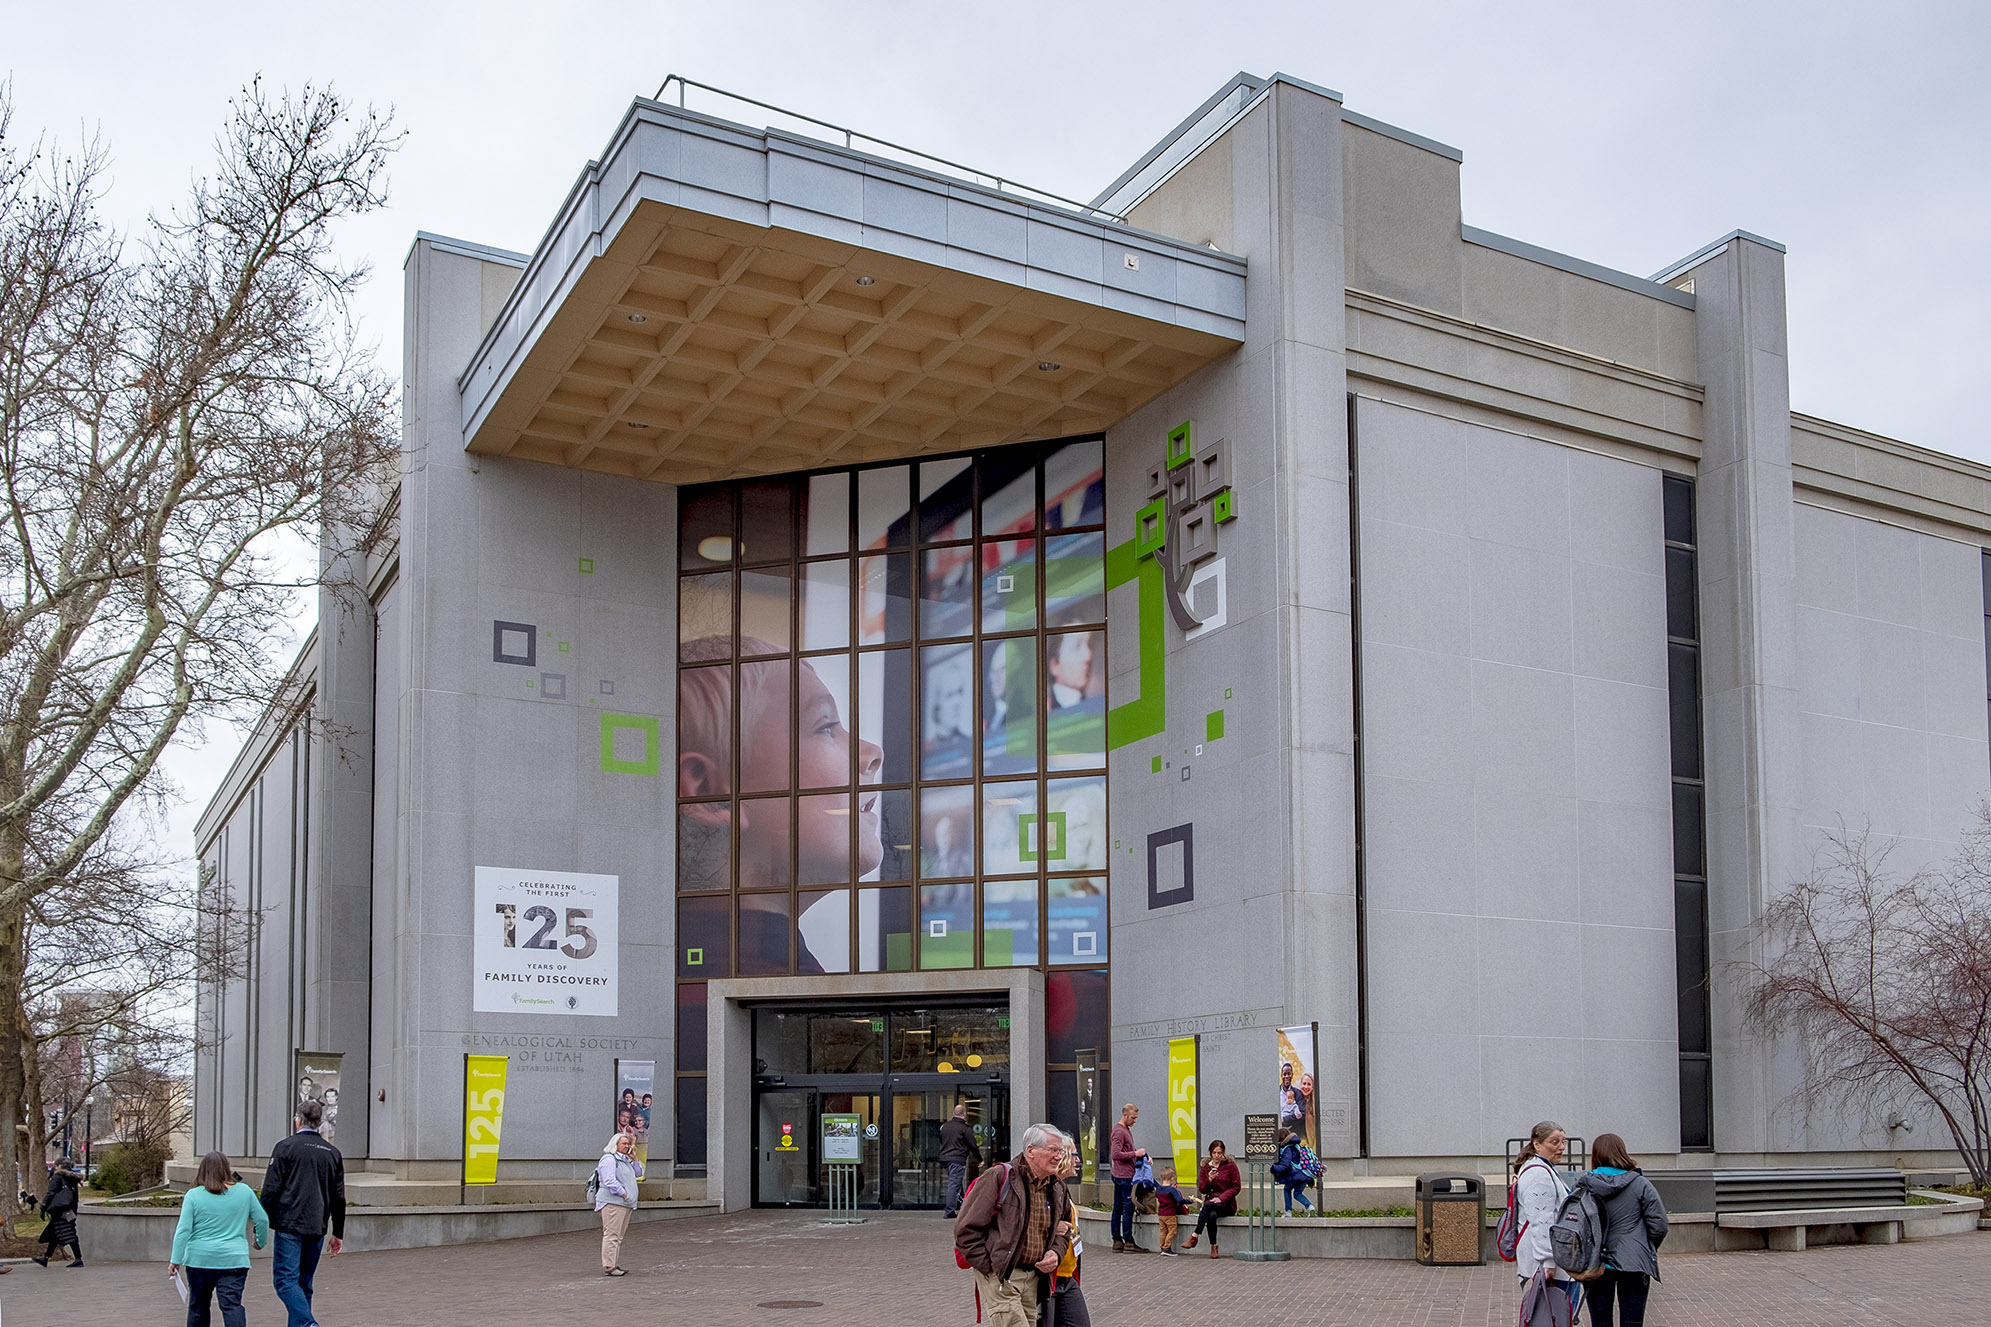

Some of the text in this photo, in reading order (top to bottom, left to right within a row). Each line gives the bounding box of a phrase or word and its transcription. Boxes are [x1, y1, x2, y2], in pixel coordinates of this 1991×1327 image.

[519, 881, 577, 891] CELEBRATING
[495, 903, 598, 960] 125
[485, 972, 608, 986] FAMILY DISCOVERY
[519, 997, 555, 1005] FamilySearch
[1129, 1013, 1258, 1038] FAMILY HISTORY LIBRARY
[461, 1034, 638, 1050] GENEALOGICAL SOCIETY
[1210, 1033, 1231, 1042] CHRIST
[519, 1050, 582, 1063] OF UTAH
[517, 1065, 566, 1073] ESTABLISHED
[1172, 1074, 1197, 1156] 125
[1321, 1109, 1345, 1117] ECTED
[469, 1088, 505, 1159] 125
